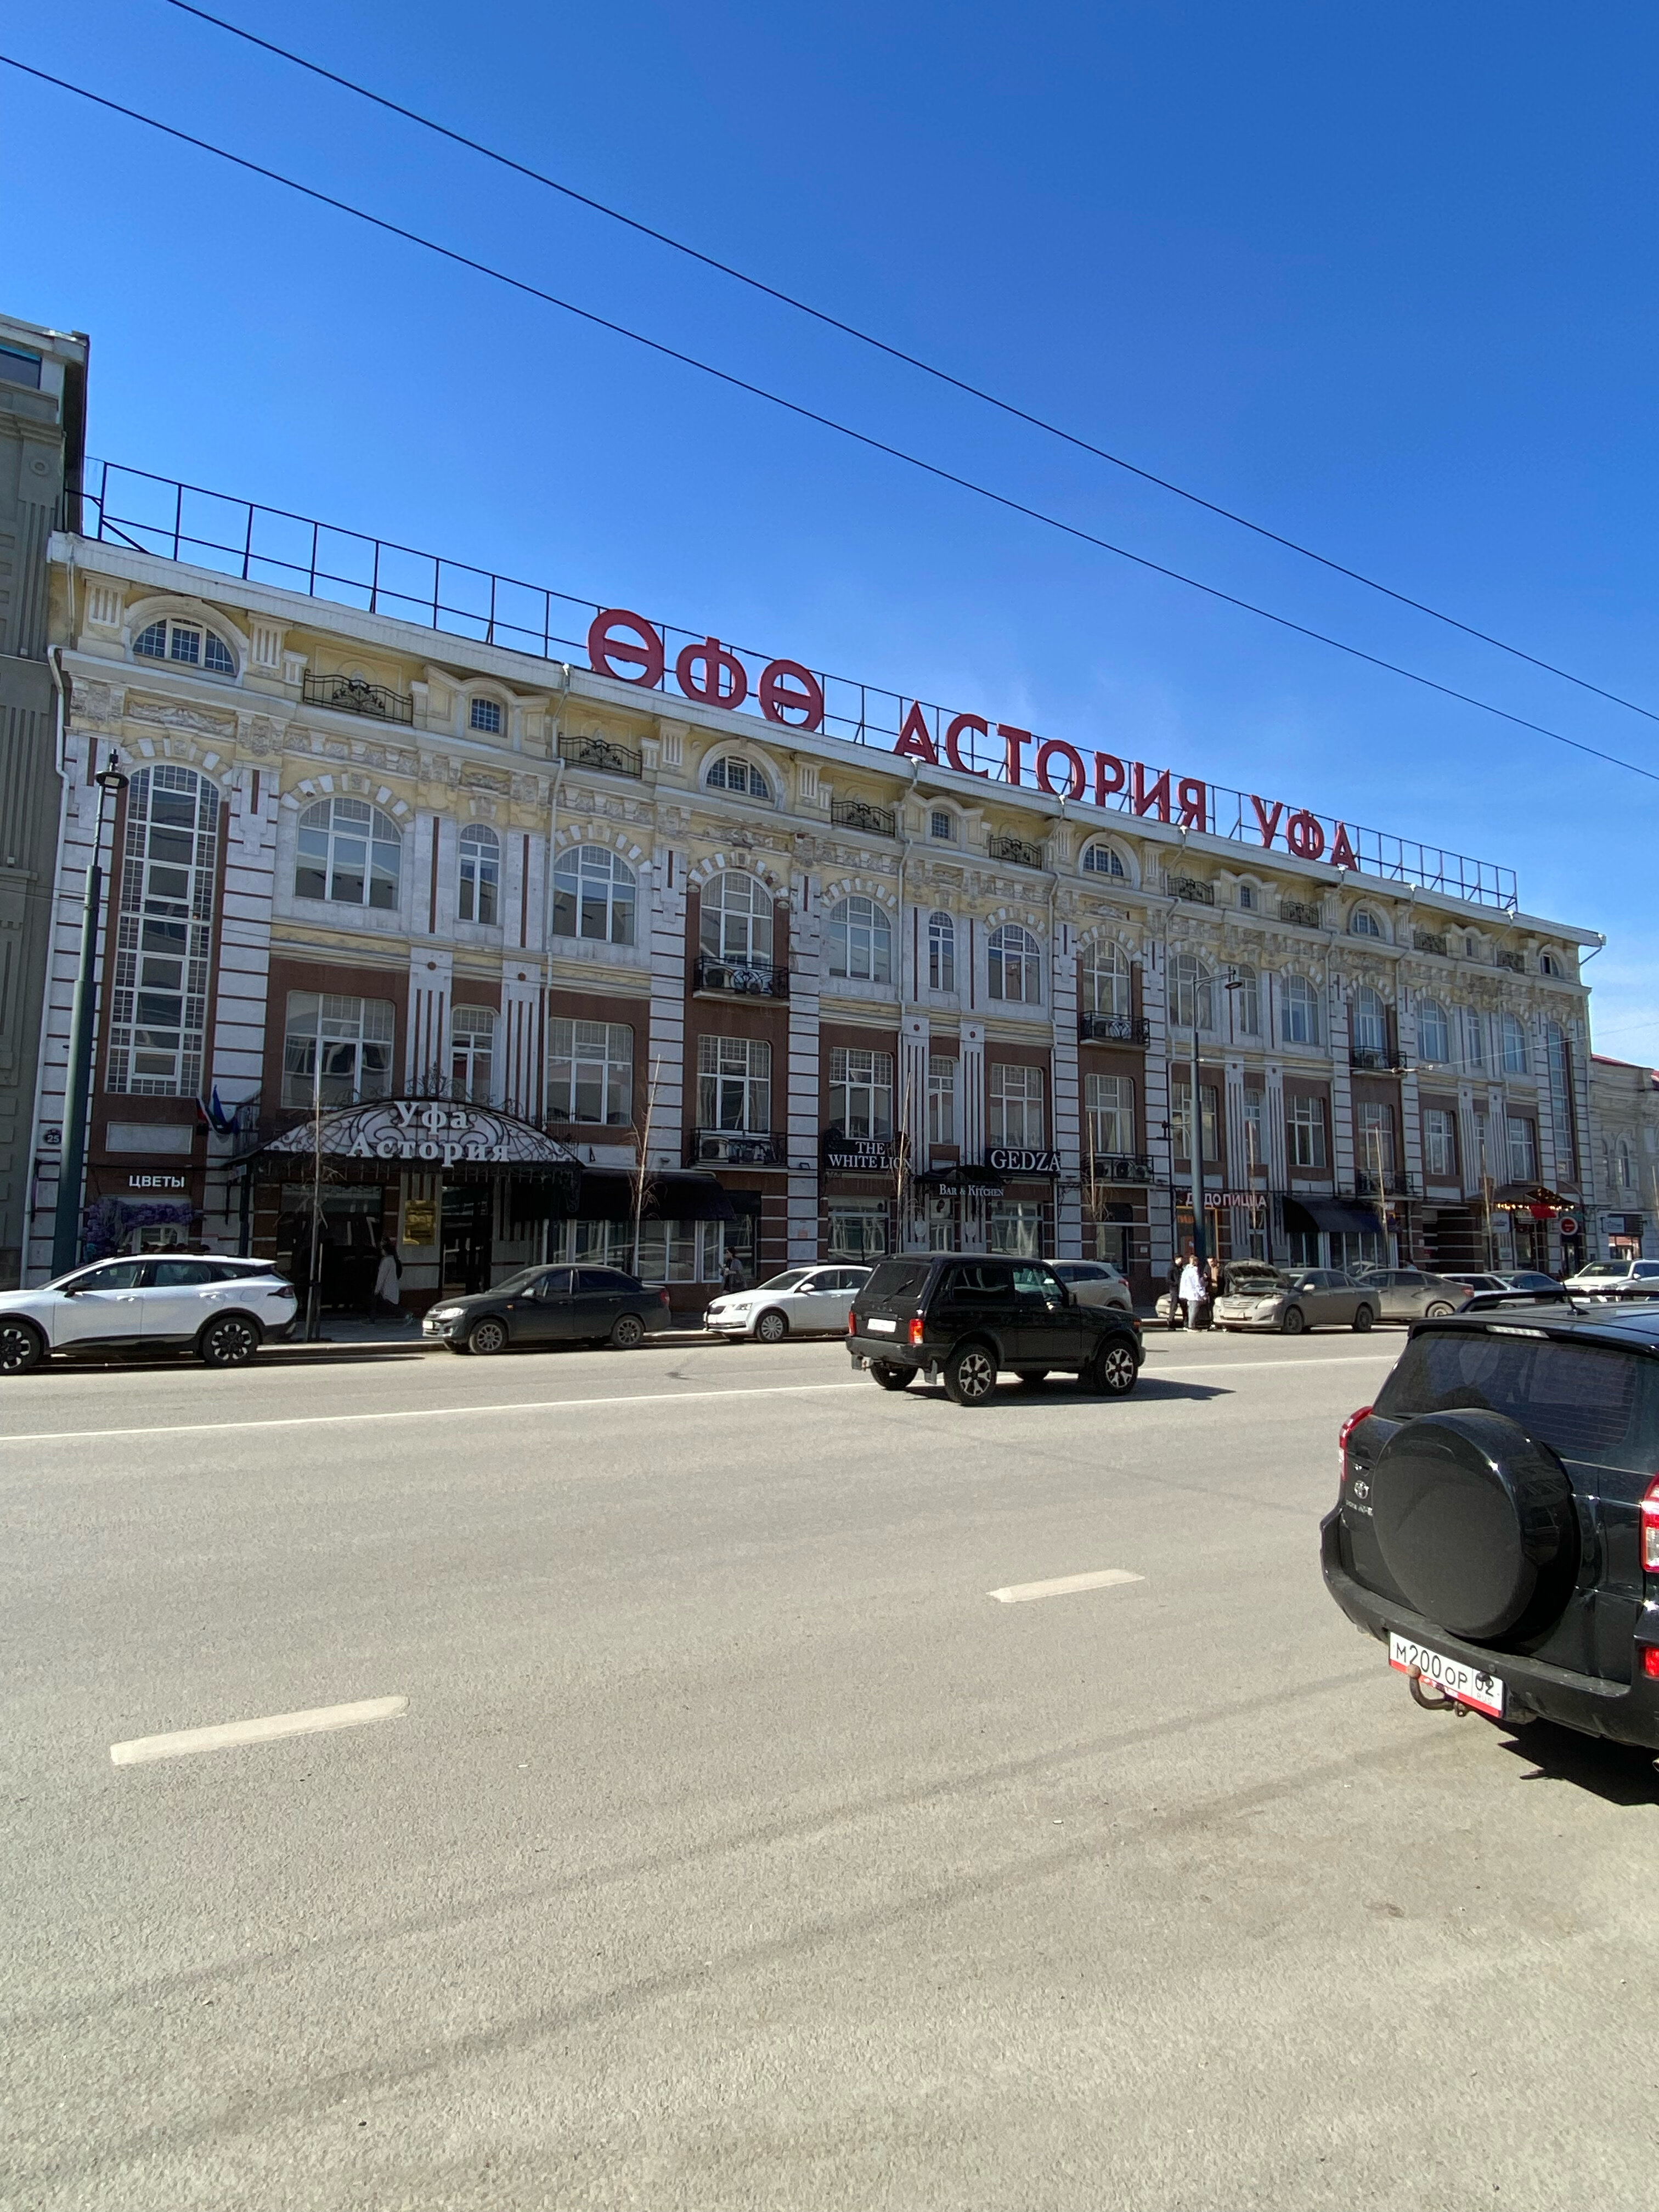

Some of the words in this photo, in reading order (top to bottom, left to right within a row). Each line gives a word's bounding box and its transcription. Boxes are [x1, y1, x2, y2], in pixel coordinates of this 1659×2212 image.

[893, 699, 1206, 833] АСТОРИЯ
[1250, 794, 1358, 871] УФА
[394, 1101, 469, 1135] Уфа
[47, 1135, 60, 1143] 25
[855, 1141, 885, 1154] THE
[346, 1131, 510, 1169] Астория
[828, 1154, 878, 1168] WHITE
[991, 1150, 1061, 1172] GEDZA
[129, 1175, 185, 1188] ЦВЕТЫ
